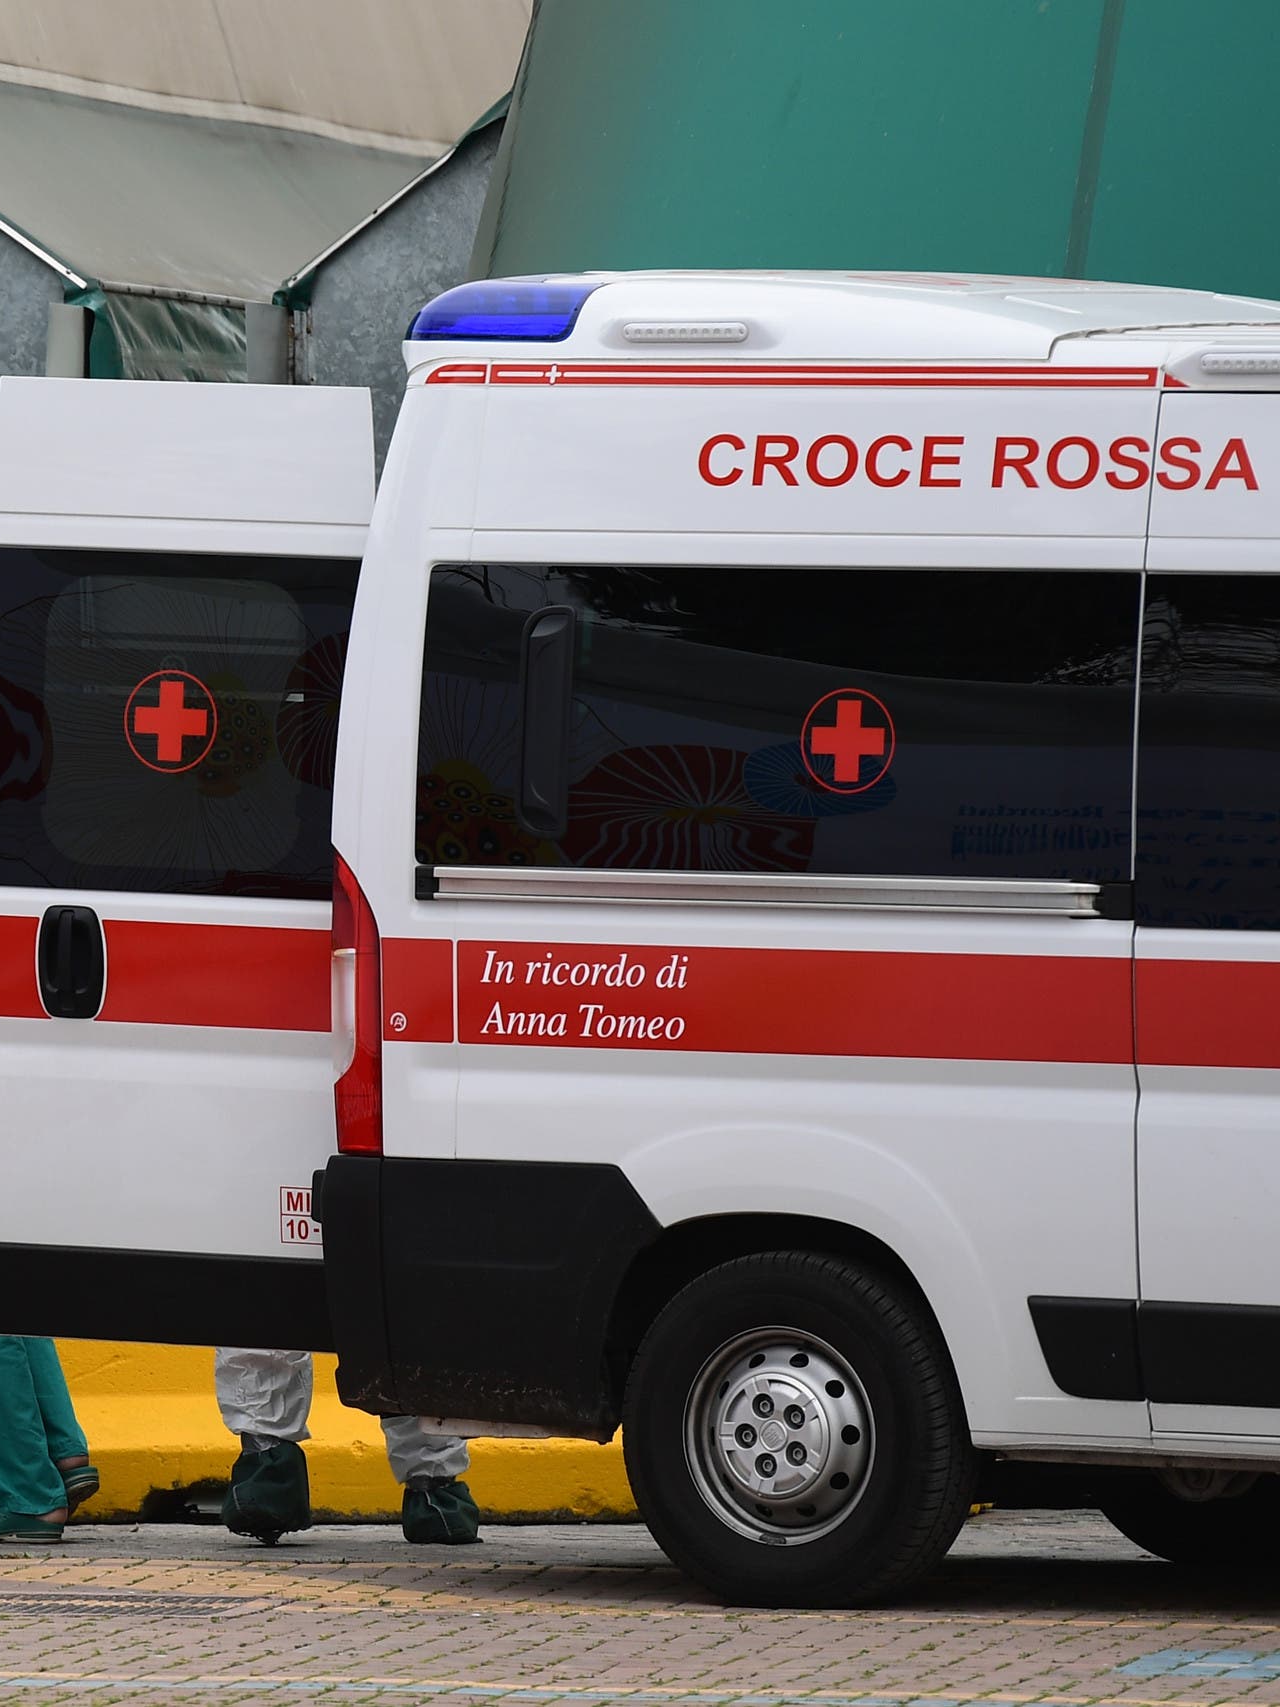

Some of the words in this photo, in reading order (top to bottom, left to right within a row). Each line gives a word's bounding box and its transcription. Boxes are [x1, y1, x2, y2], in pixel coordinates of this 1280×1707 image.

[698, 433, 965, 489] CROCE
[991, 436, 1260, 491] ROSSA
[480, 950, 514, 984] In
[524, 952, 645, 988] ricordo
[655, 955, 688, 989] di
[480, 1001, 567, 1035] Anna
[578, 1004, 686, 1041] Tomeo
[287, 1191, 310, 1212] MI
